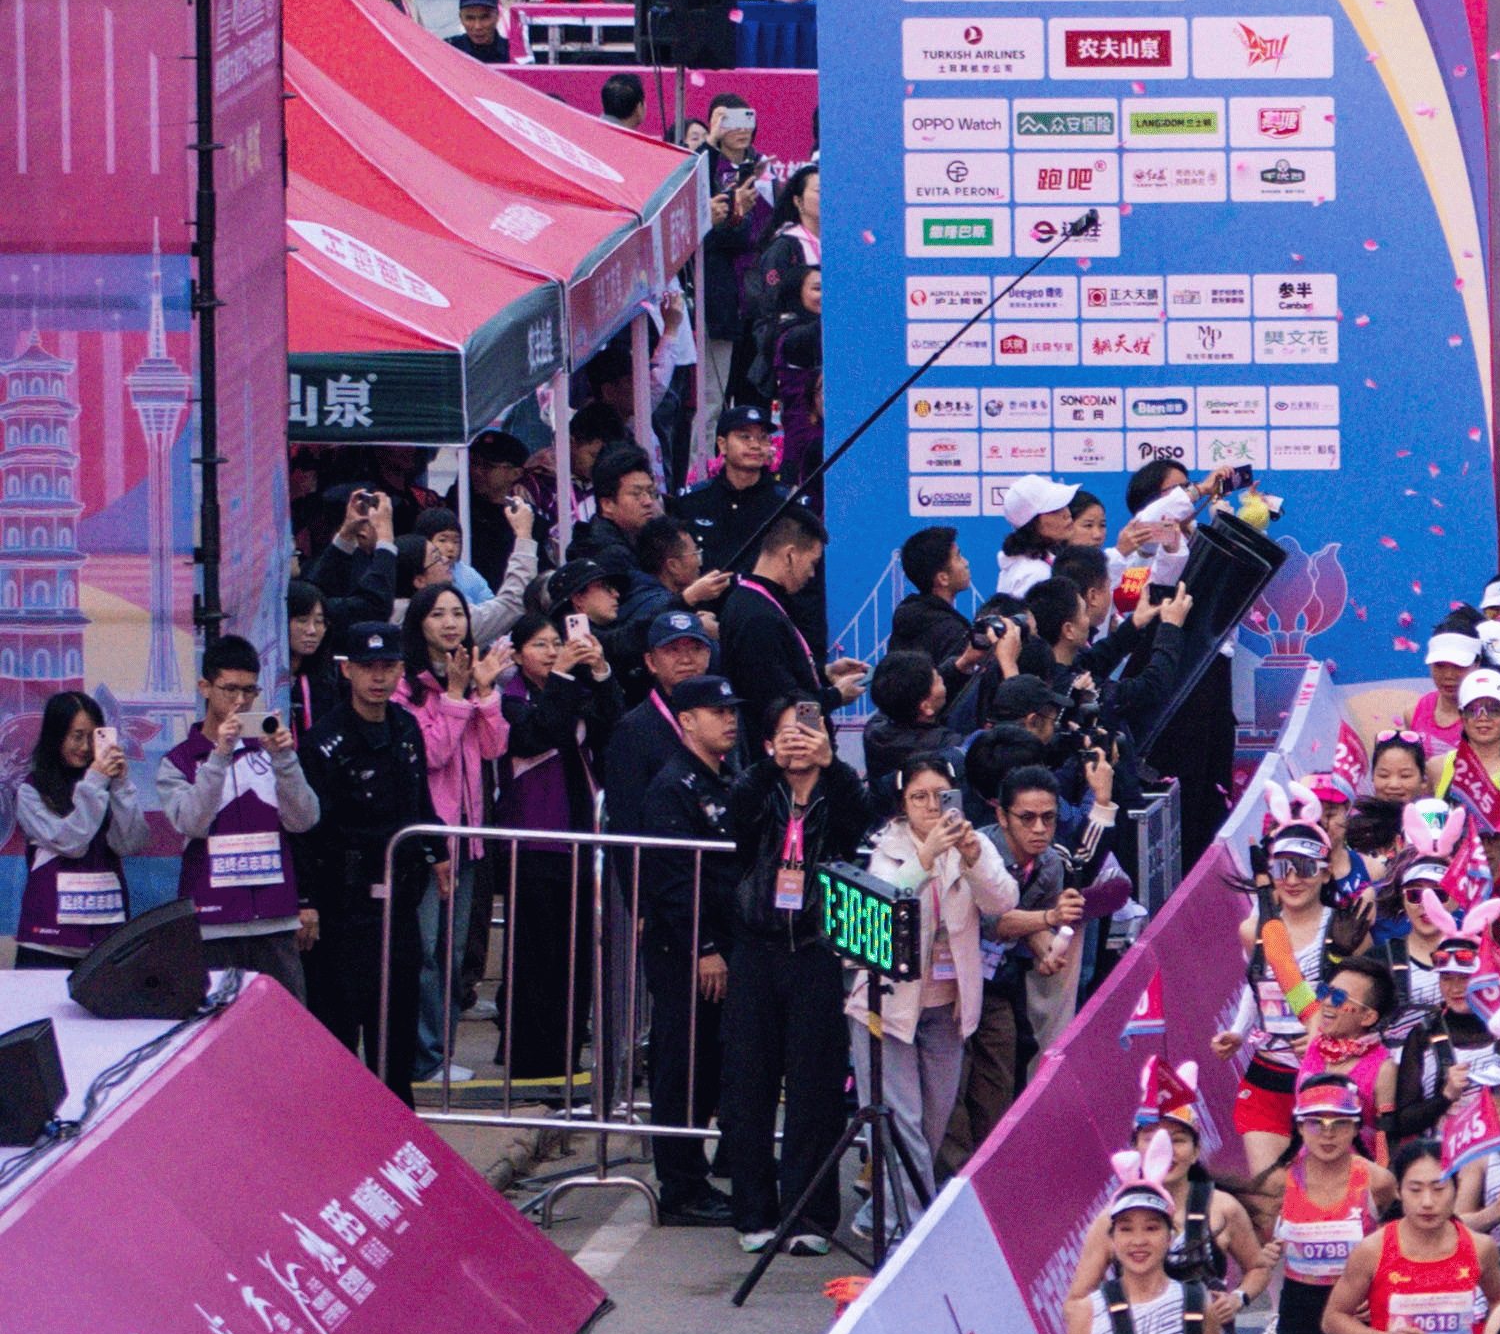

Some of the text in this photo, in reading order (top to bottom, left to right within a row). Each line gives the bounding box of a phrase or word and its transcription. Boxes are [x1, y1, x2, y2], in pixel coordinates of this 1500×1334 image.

[922, 50, 1026, 60] TURKISH AIRLINES
[1078, 38, 1160, 60] 农夫山泉
[912, 117, 1002, 132] OPPO Watch
[1051, 114, 1114, 135] 众安保险
[1037, 168, 1093, 191] 跑吧
[916, 187, 1000, 197] EVITA PERONI
[1109, 288, 1159, 301] 正大天晴
[1278, 281, 1314, 299] 参半
[1264, 329, 1328, 348] 樊文花
[1060, 396, 1116, 406] SONGDIAN
[1139, 442, 1185, 461] Pisso
[1454, 757, 1493, 814] 2:45
[212, 853, 282, 878] 起终点志愿者
[1449, 1115, 1487, 1158] 1:45
[1303, 1241, 1347, 1259] 0798
[1413, 1314, 1459, 1334] 0618
